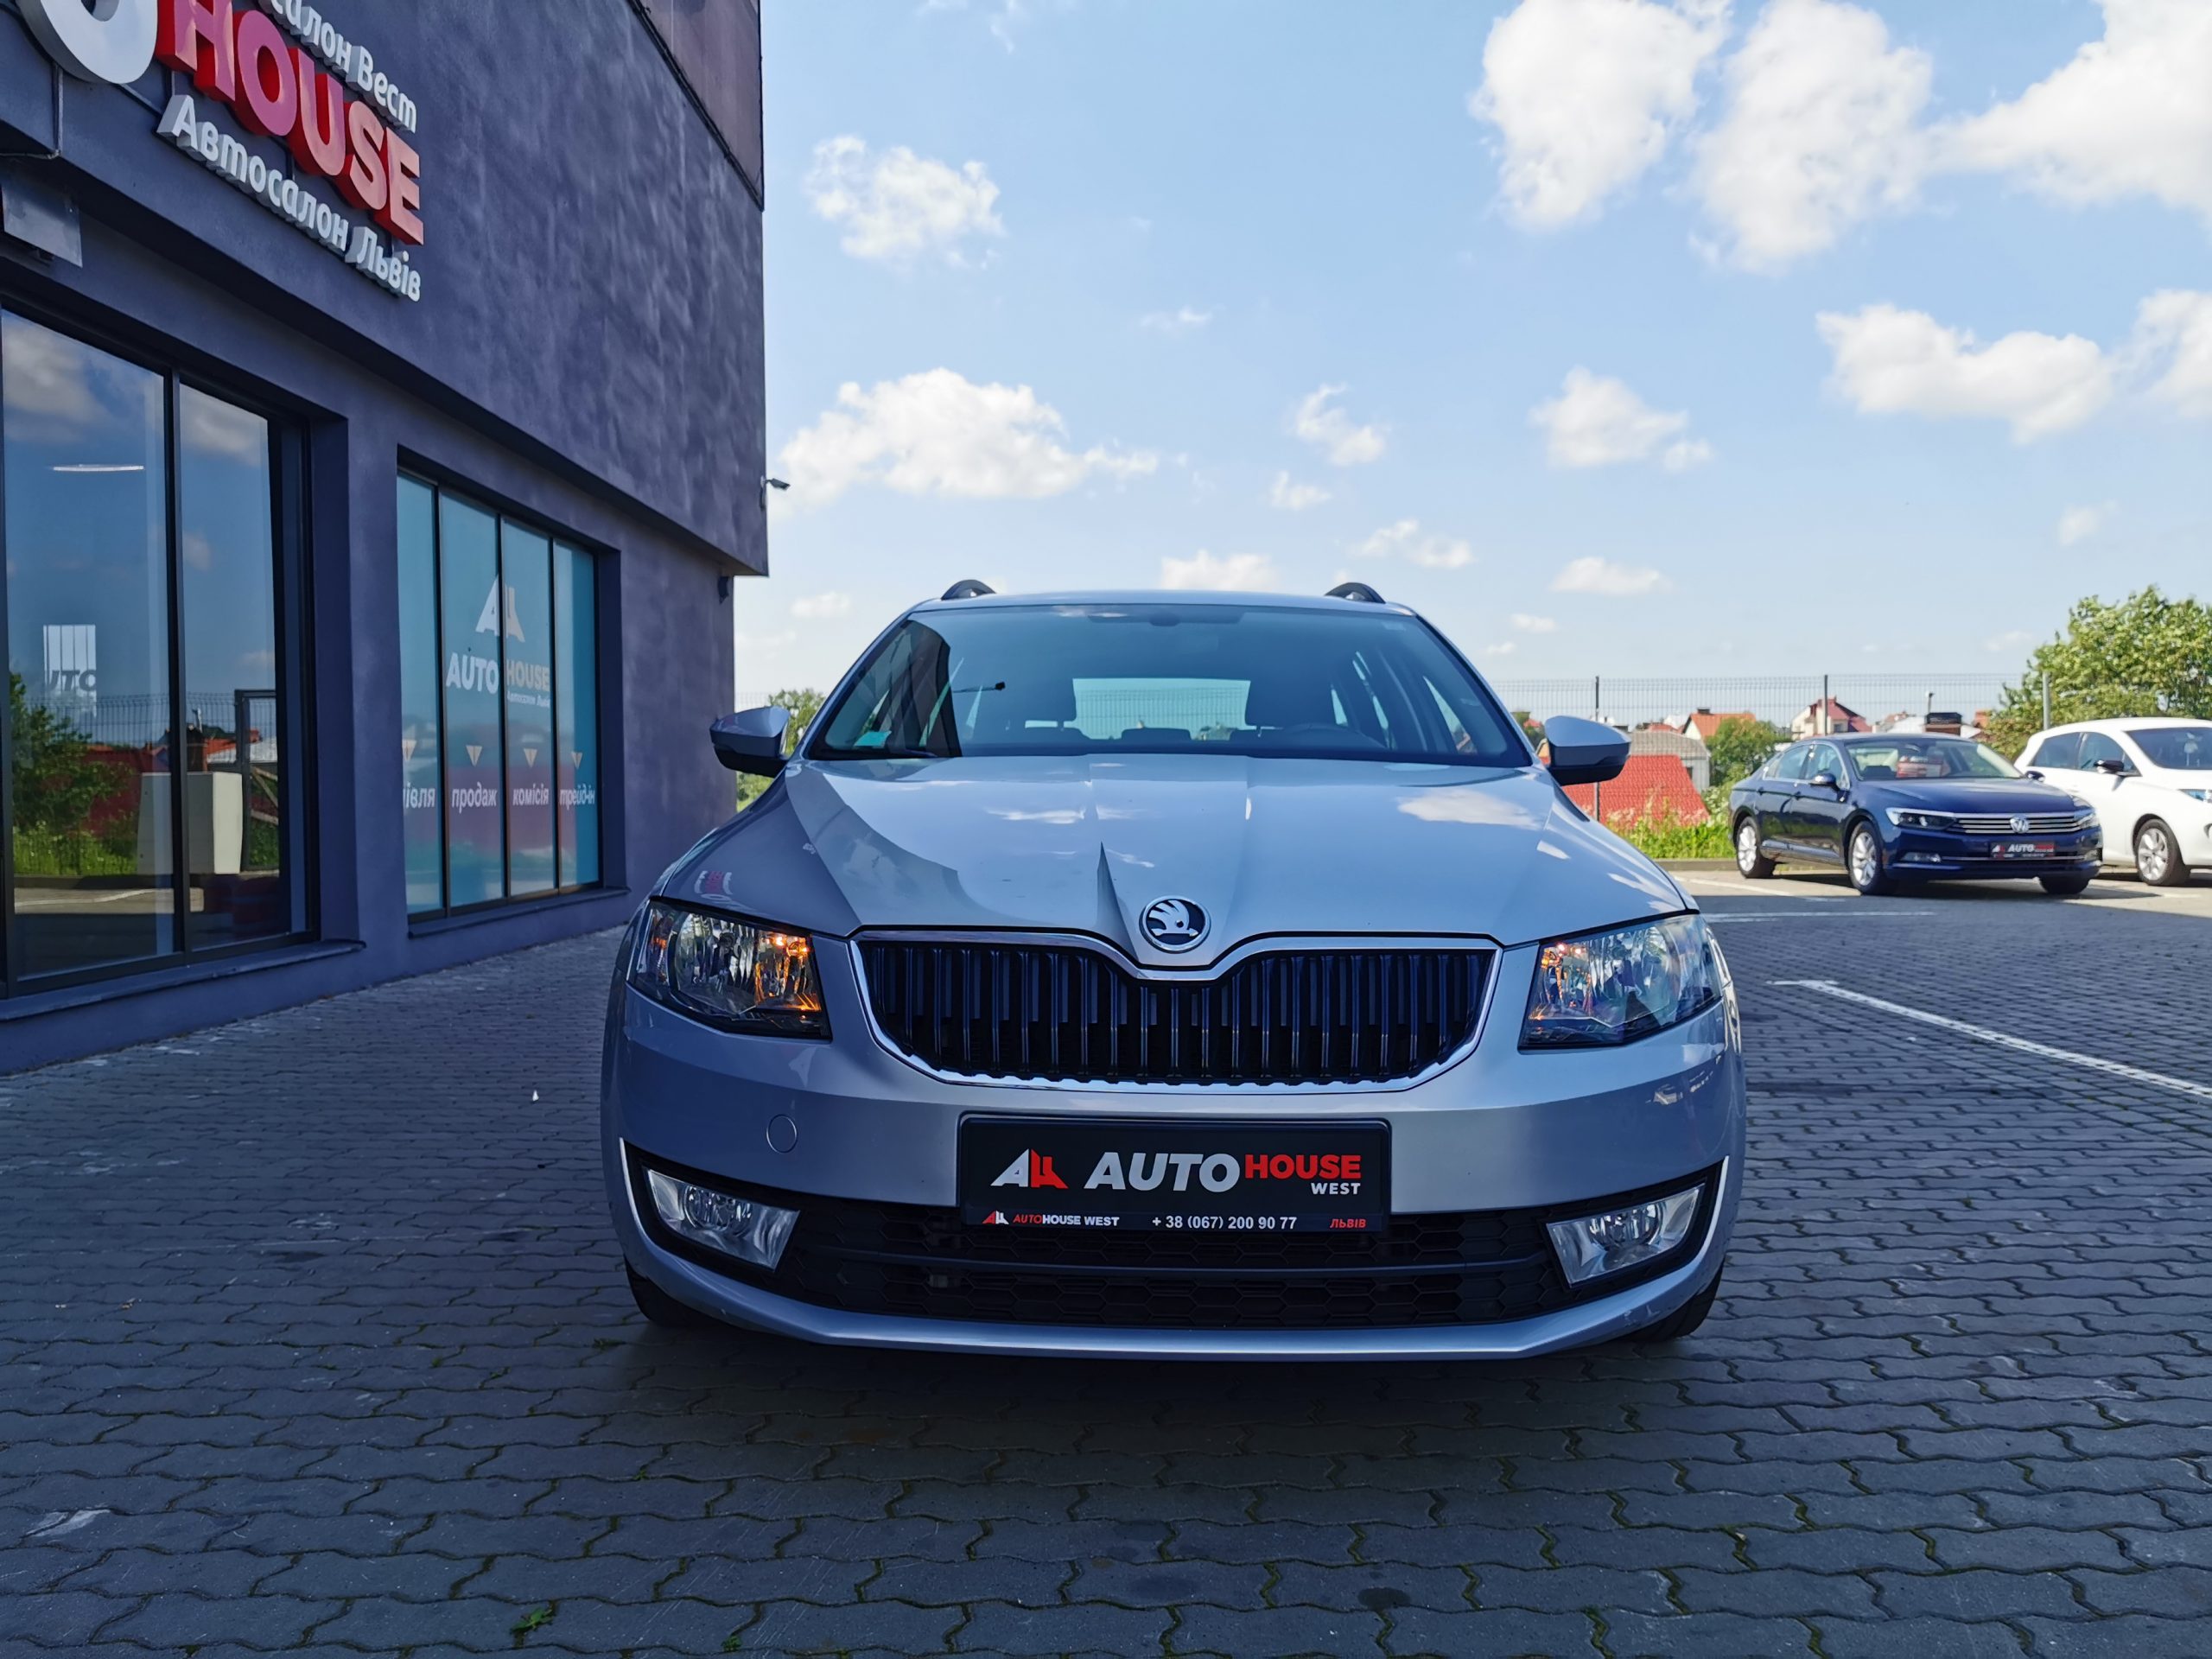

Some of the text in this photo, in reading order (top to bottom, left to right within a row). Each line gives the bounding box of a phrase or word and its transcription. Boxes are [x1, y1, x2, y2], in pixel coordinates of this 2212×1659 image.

[357, 46, 416, 134] Вест
[172, 0, 424, 245] HOUSE
[172, 95, 421, 302] Автосалон Львів
[446, 652, 550, 695] AUTO HOUSE
[451, 782, 498, 813] продаж
[512, 784, 550, 806] комісія
[1083, 1152, 1362, 1192] AUTO HOUSE
[1311, 1182, 1362, 1195] WEST
[1084, 1216, 1120, 1227] WEST
[1166, 1216, 1183, 1229] 38
[1187, 1216, 1224, 1230] (067)
[1228, 1216, 1254, 1230] 200
[1258, 1217, 1275, 1230] 90
[1280, 1217, 1297, 1230] 77
[1330, 1218, 1367, 1229] ЛЬВІВ
